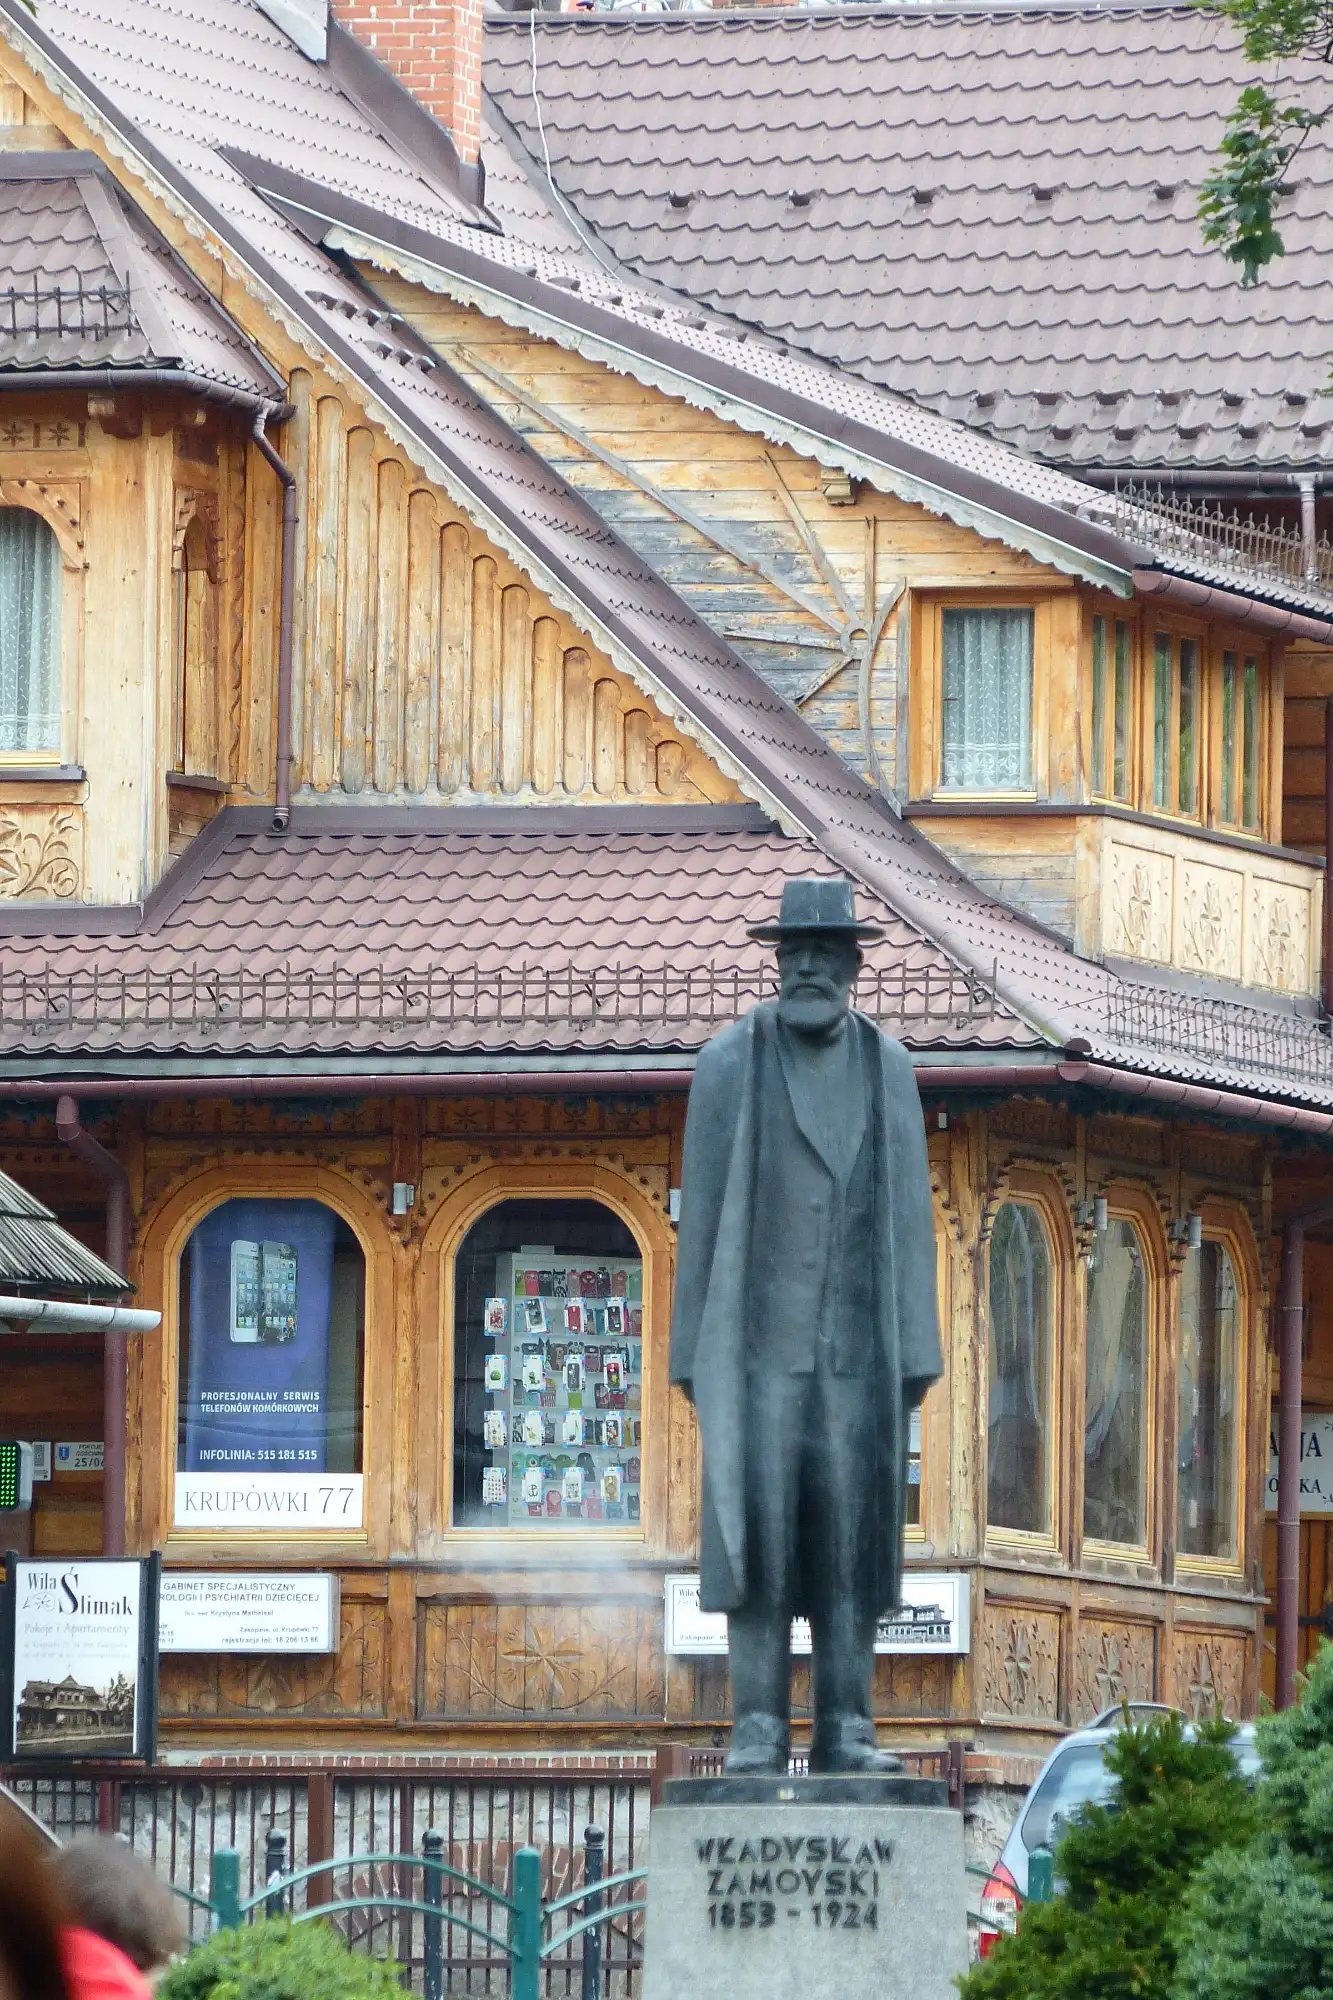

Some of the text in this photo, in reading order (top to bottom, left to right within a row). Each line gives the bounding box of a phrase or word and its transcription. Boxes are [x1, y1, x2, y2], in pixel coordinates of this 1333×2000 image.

[201, 1391, 320, 1401] PROFESJONALNY SERWIS
[201, 1402, 319, 1413] TELEFONÓW KOMÓRKOWYCH
[200, 1449, 317, 1460] INFOLINIA: 515 181 515
[185, 1484, 354, 1514] KRUPÓWKI 77
[58, 1566, 132, 1615] Ślimak
[163, 1582, 296, 1591] GABINET SPECJALISTYCZNY
[159, 1593, 198, 1602] ROLOGII
[205, 1593, 263, 1602] PSYCHIATRII
[265, 1593, 320, 1604] DZIECIĘCEJ
[24, 1622, 53, 1636] Pokoje
[63, 1622, 130, 1637] Apartamenty
[694, 1836, 895, 1865] WŁADYSŁAW
[707, 1868, 879, 1898] ZAMOYSKI
[708, 1900, 776, 1929] 1853
[811, 1900, 879, 1931] 1924
